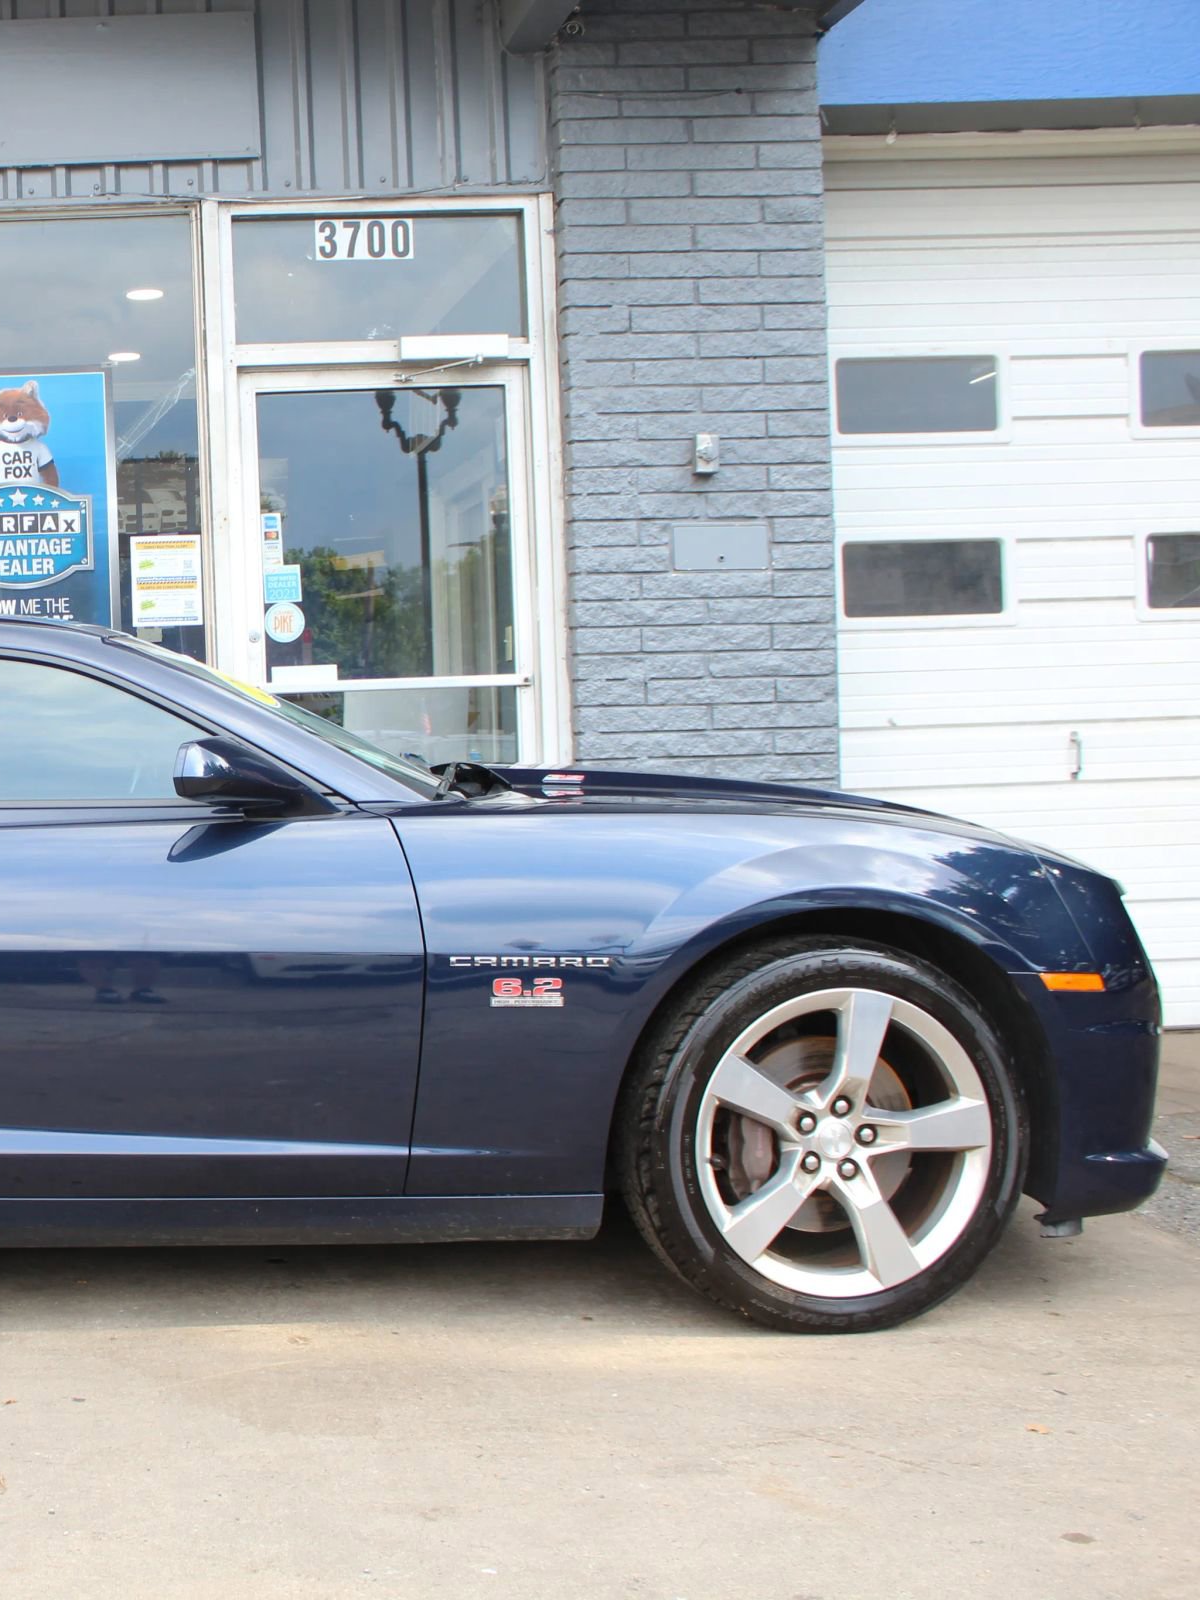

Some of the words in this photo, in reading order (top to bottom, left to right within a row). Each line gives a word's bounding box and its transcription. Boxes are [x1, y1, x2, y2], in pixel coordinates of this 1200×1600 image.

[318, 220, 410, 258] 3700
[2, 451, 33, 465] CAR
[4, 465, 33, 479] FOX
[271, 588, 298, 600] 2021
[20, 599, 42, 615] ME
[43, 598, 71, 614] THE
[274, 614, 295, 634] PIKE
[449, 956, 610, 968] CAMARO
[492, 977, 563, 997] 6.2
